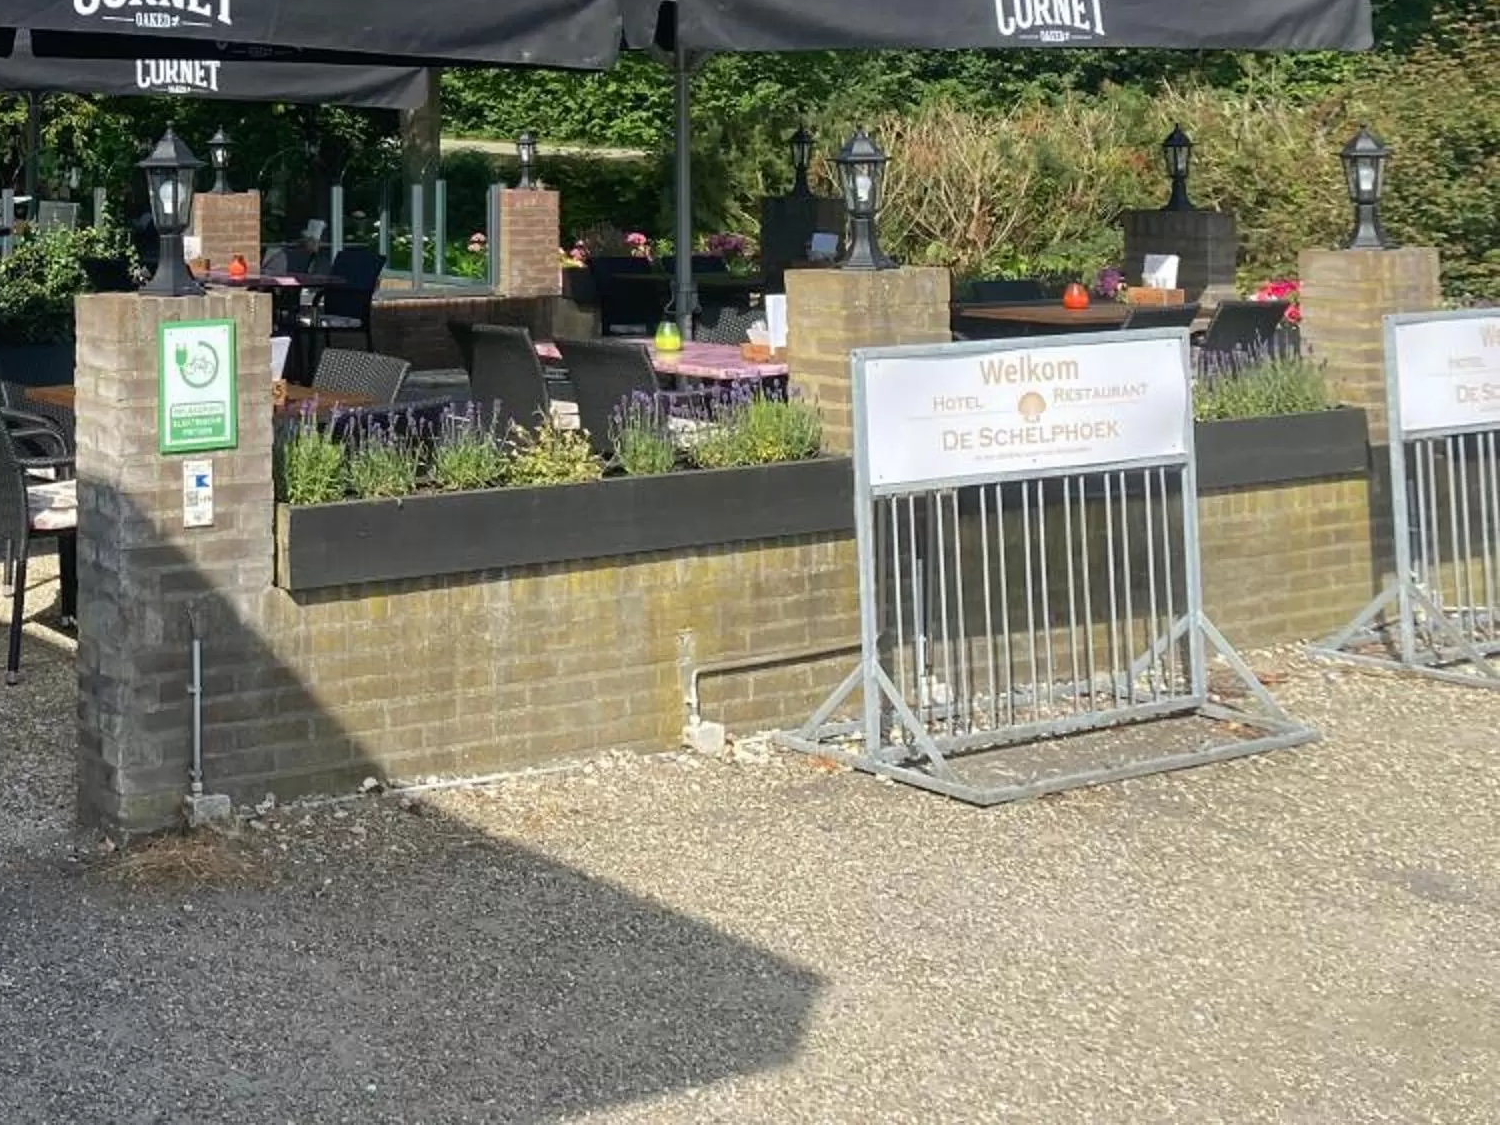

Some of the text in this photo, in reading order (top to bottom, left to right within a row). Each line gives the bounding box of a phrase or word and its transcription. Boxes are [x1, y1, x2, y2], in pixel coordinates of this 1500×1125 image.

[980, 354, 1080, 385] Welkom
[932, 381, 1148, 412] HOTEL RESTAURANT
[942, 420, 1121, 451] DE SCHELPHOEK
